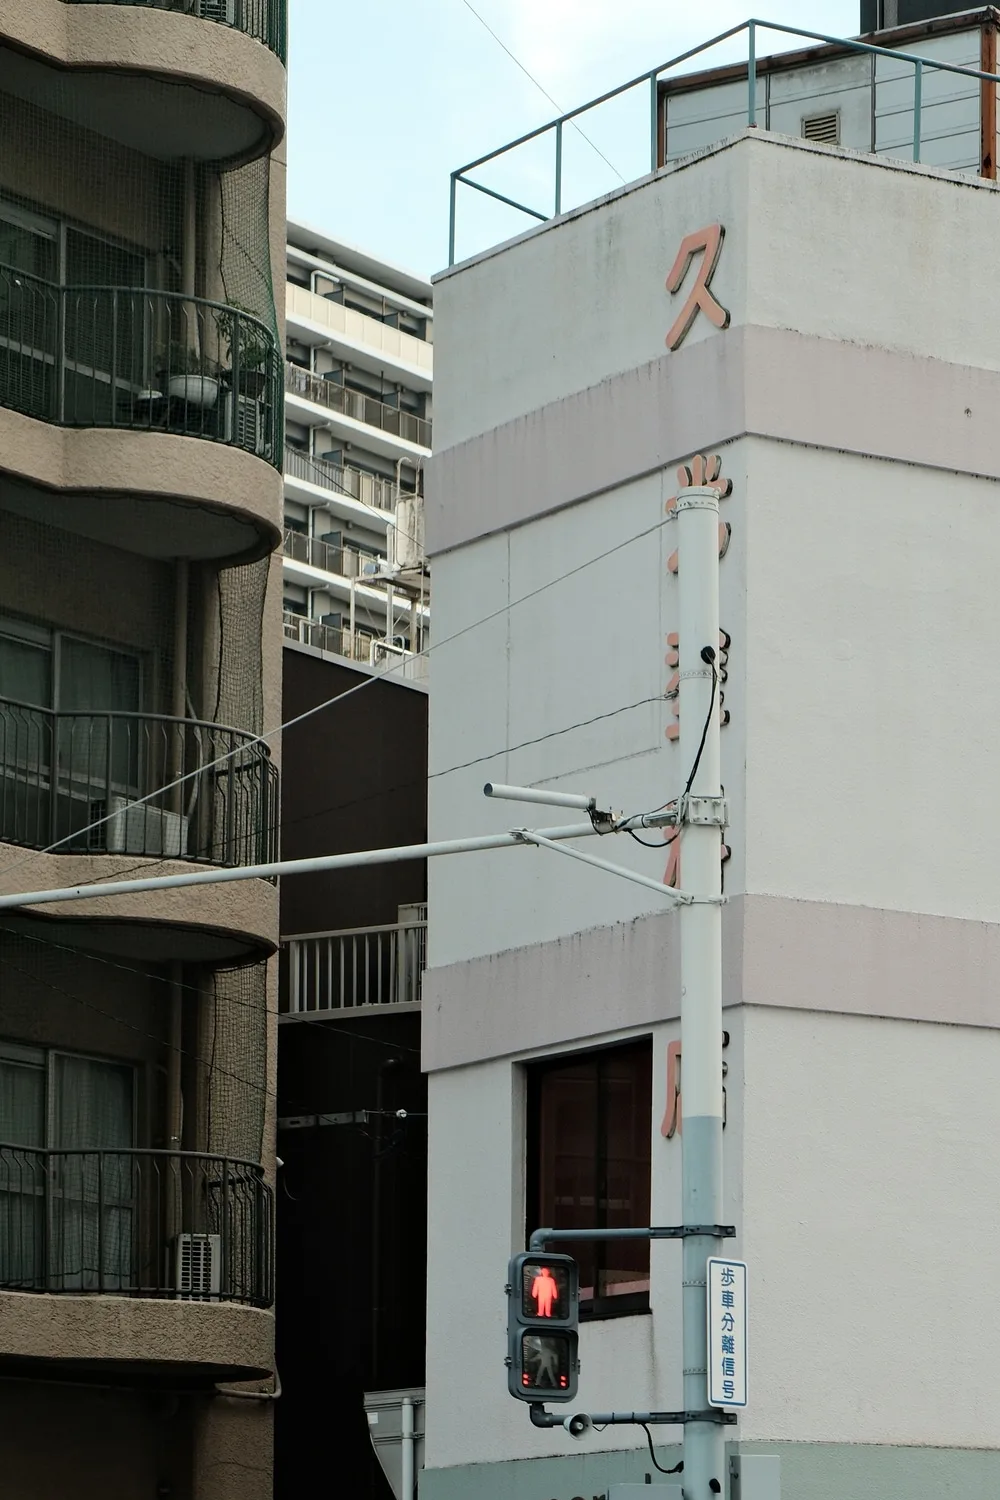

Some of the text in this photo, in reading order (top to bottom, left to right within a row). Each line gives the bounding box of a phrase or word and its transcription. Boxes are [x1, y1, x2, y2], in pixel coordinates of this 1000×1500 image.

[721, 1267, 735, 1399] 歩車分離信号
